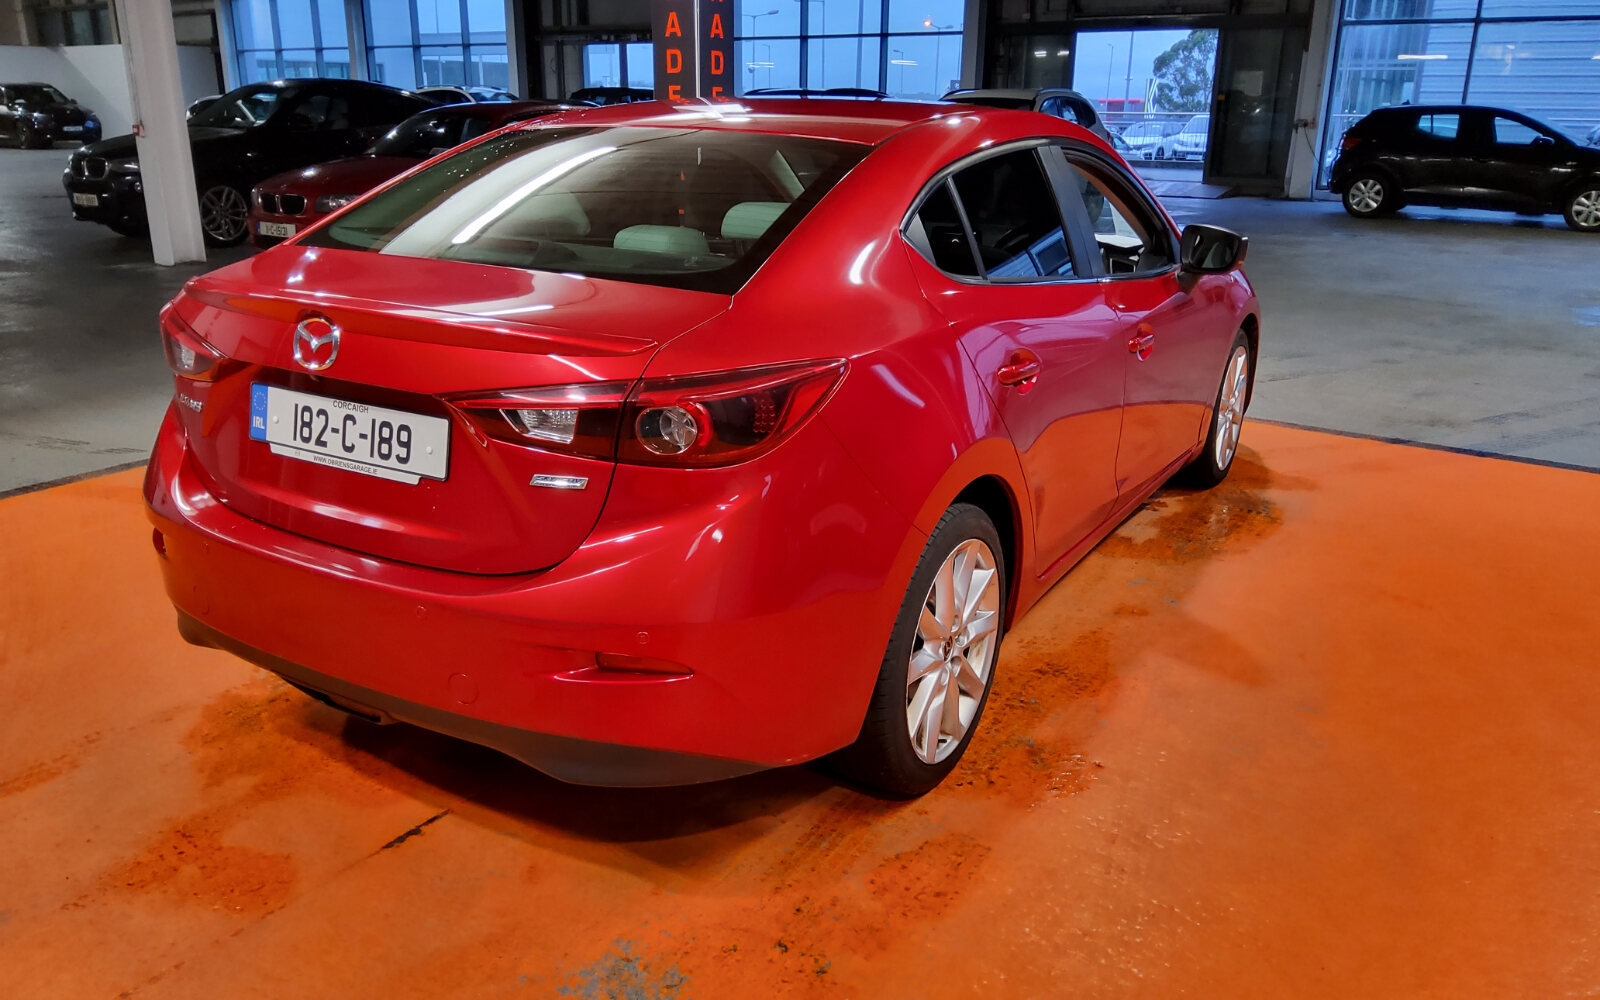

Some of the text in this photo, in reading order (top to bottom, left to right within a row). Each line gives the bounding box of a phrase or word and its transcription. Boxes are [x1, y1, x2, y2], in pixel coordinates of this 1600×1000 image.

[332, 400, 369, 414] CORCAIGH
[252, 415, 266, 430] IRL
[292, 402, 413, 465] 182-C-189
